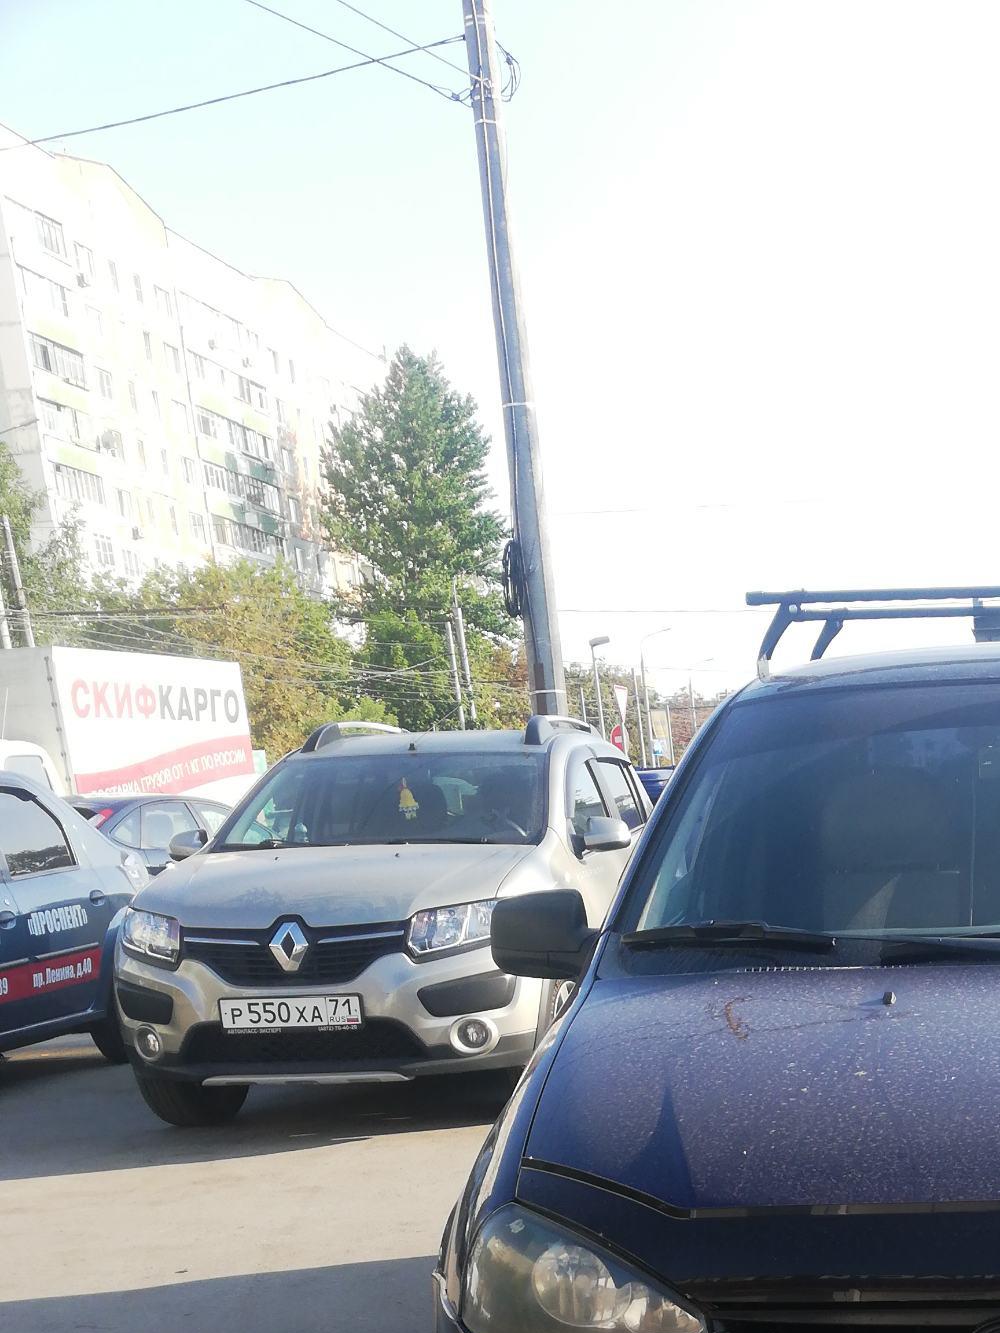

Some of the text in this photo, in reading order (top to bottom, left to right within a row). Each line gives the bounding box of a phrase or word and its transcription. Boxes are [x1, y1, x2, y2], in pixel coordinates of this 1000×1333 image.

[70, 678, 240, 724] СКИФКАРГО
[91, 779, 141, 793] СТАВКА
[140, 768, 173, 792] ГРУЗОВ
[172, 762, 185, 782] ОТ
[191, 758, 200, 774] КГ
[200, 755, 214, 770] ПО
[214, 748, 247, 768] РОССИИ
[328, 998, 352, 1016] 71
